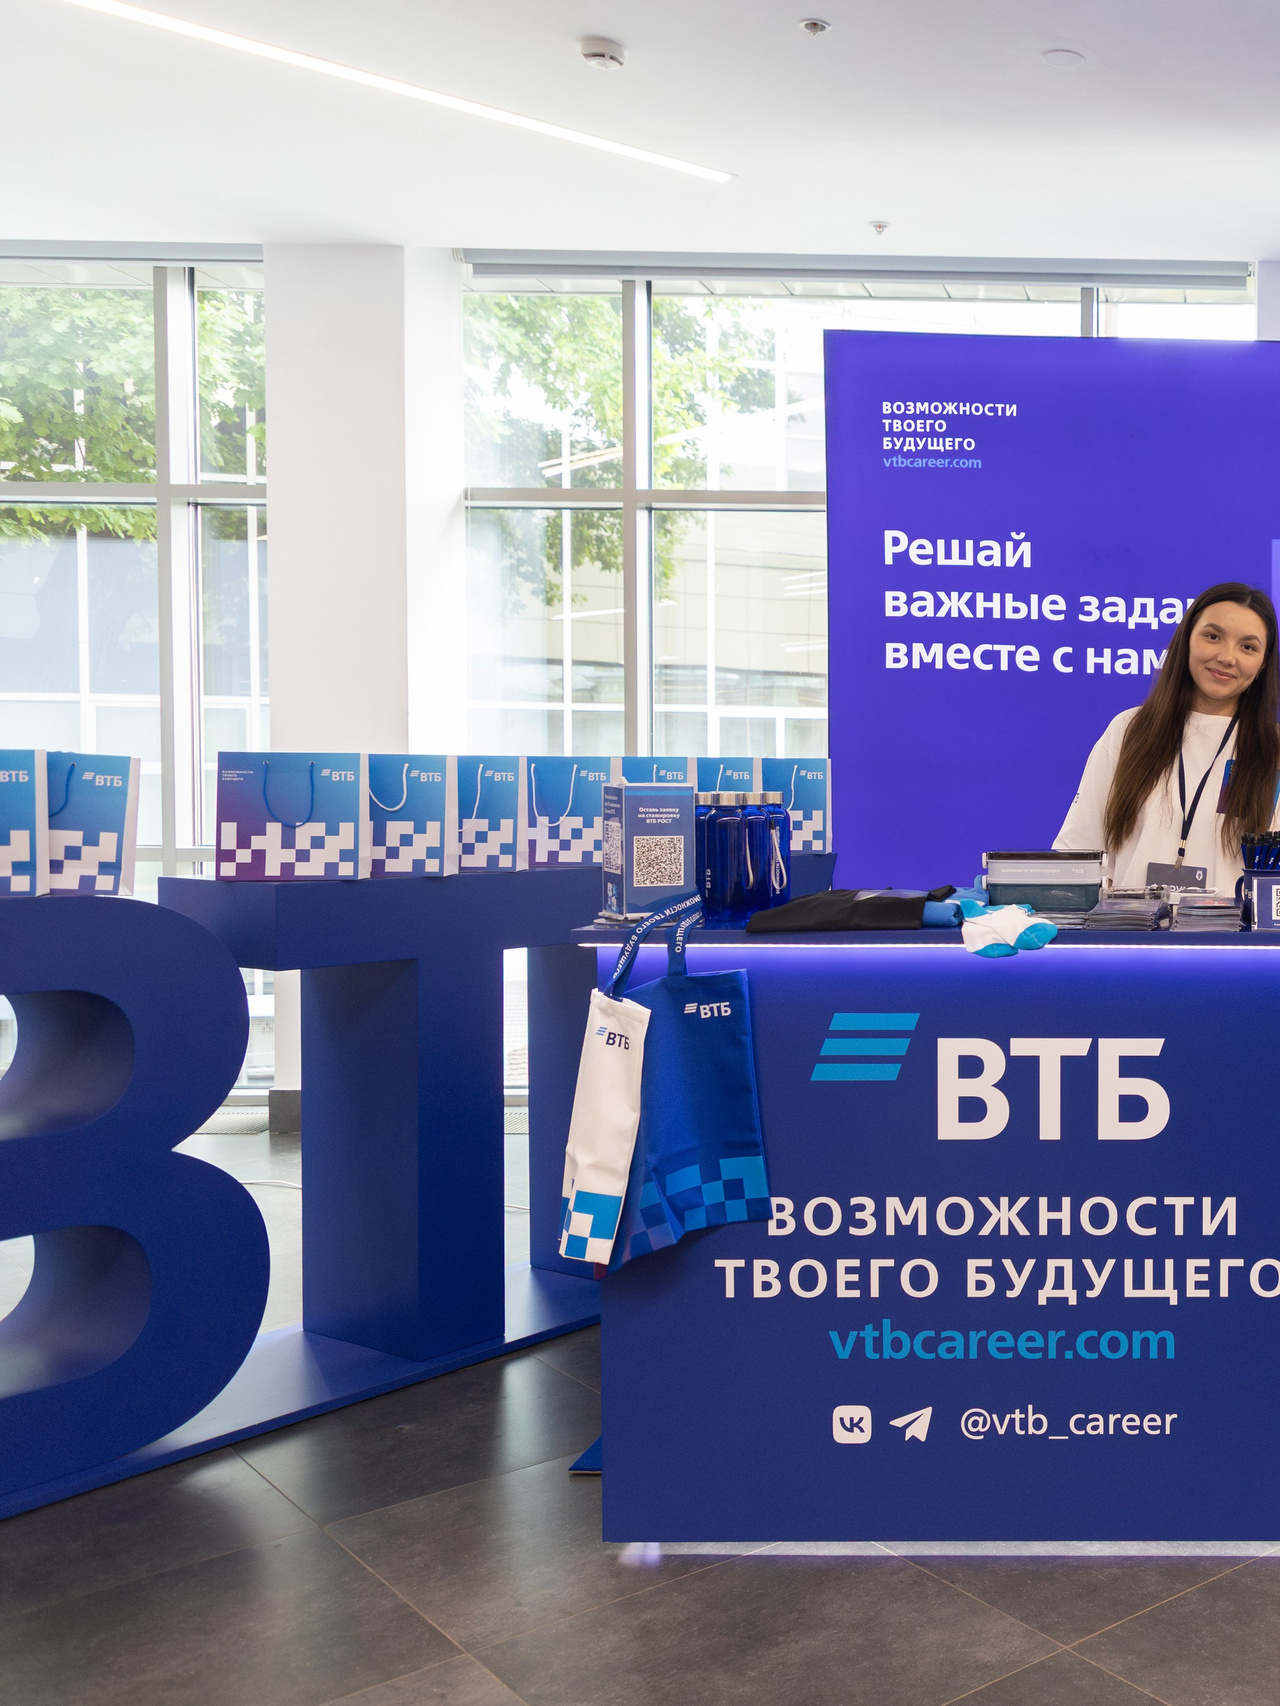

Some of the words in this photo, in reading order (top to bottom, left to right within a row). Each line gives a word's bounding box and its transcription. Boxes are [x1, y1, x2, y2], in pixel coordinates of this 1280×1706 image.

[883, 402, 1017, 417] ВОЗМОЖНОСТИ
[882, 419, 947, 432] ТВОЕГО
[883, 437, 976, 452] БУДУЩЕГО
[883, 454, 982, 469] vtbcareer.com
[884, 530, 1032, 568] Решай
[885, 590, 1067, 621] важные
[1078, 595, 1194, 630] зада
[885, 642, 1041, 672] вместе
[1052, 646, 1074, 673] с
[0, 770, 29, 782] ВТБ
[95, 775, 123, 787] ВТБ
[331, 771, 355, 782] ВТБ
[419, 772, 442, 782] ВТБ
[494, 772, 515, 782] ВТБ
[588, 772, 607, 782] ВТБ
[666, 772, 684, 780] ВТБ
[733, 771, 750, 780] ВТБ
[807, 771, 824, 780] ВТБ
[636, 913, 665, 934] ТВОЕГО
[612, 934, 638, 979] БУДУЩЕГО
[699, 1002, 732, 1019] ВТБ
[606, 1032, 630, 1050] ВТБ
[937, 1038, 1171, 1141] ВТБ
[768, 1196, 1237, 1237] ВОЗМОЖНОСТИ
[715, 1258, 939, 1299] ТВОЕГО
[829, 1318, 1175, 1360] vtbcareer.com
[960, 1404, 1178, 1440] @vtb_career
